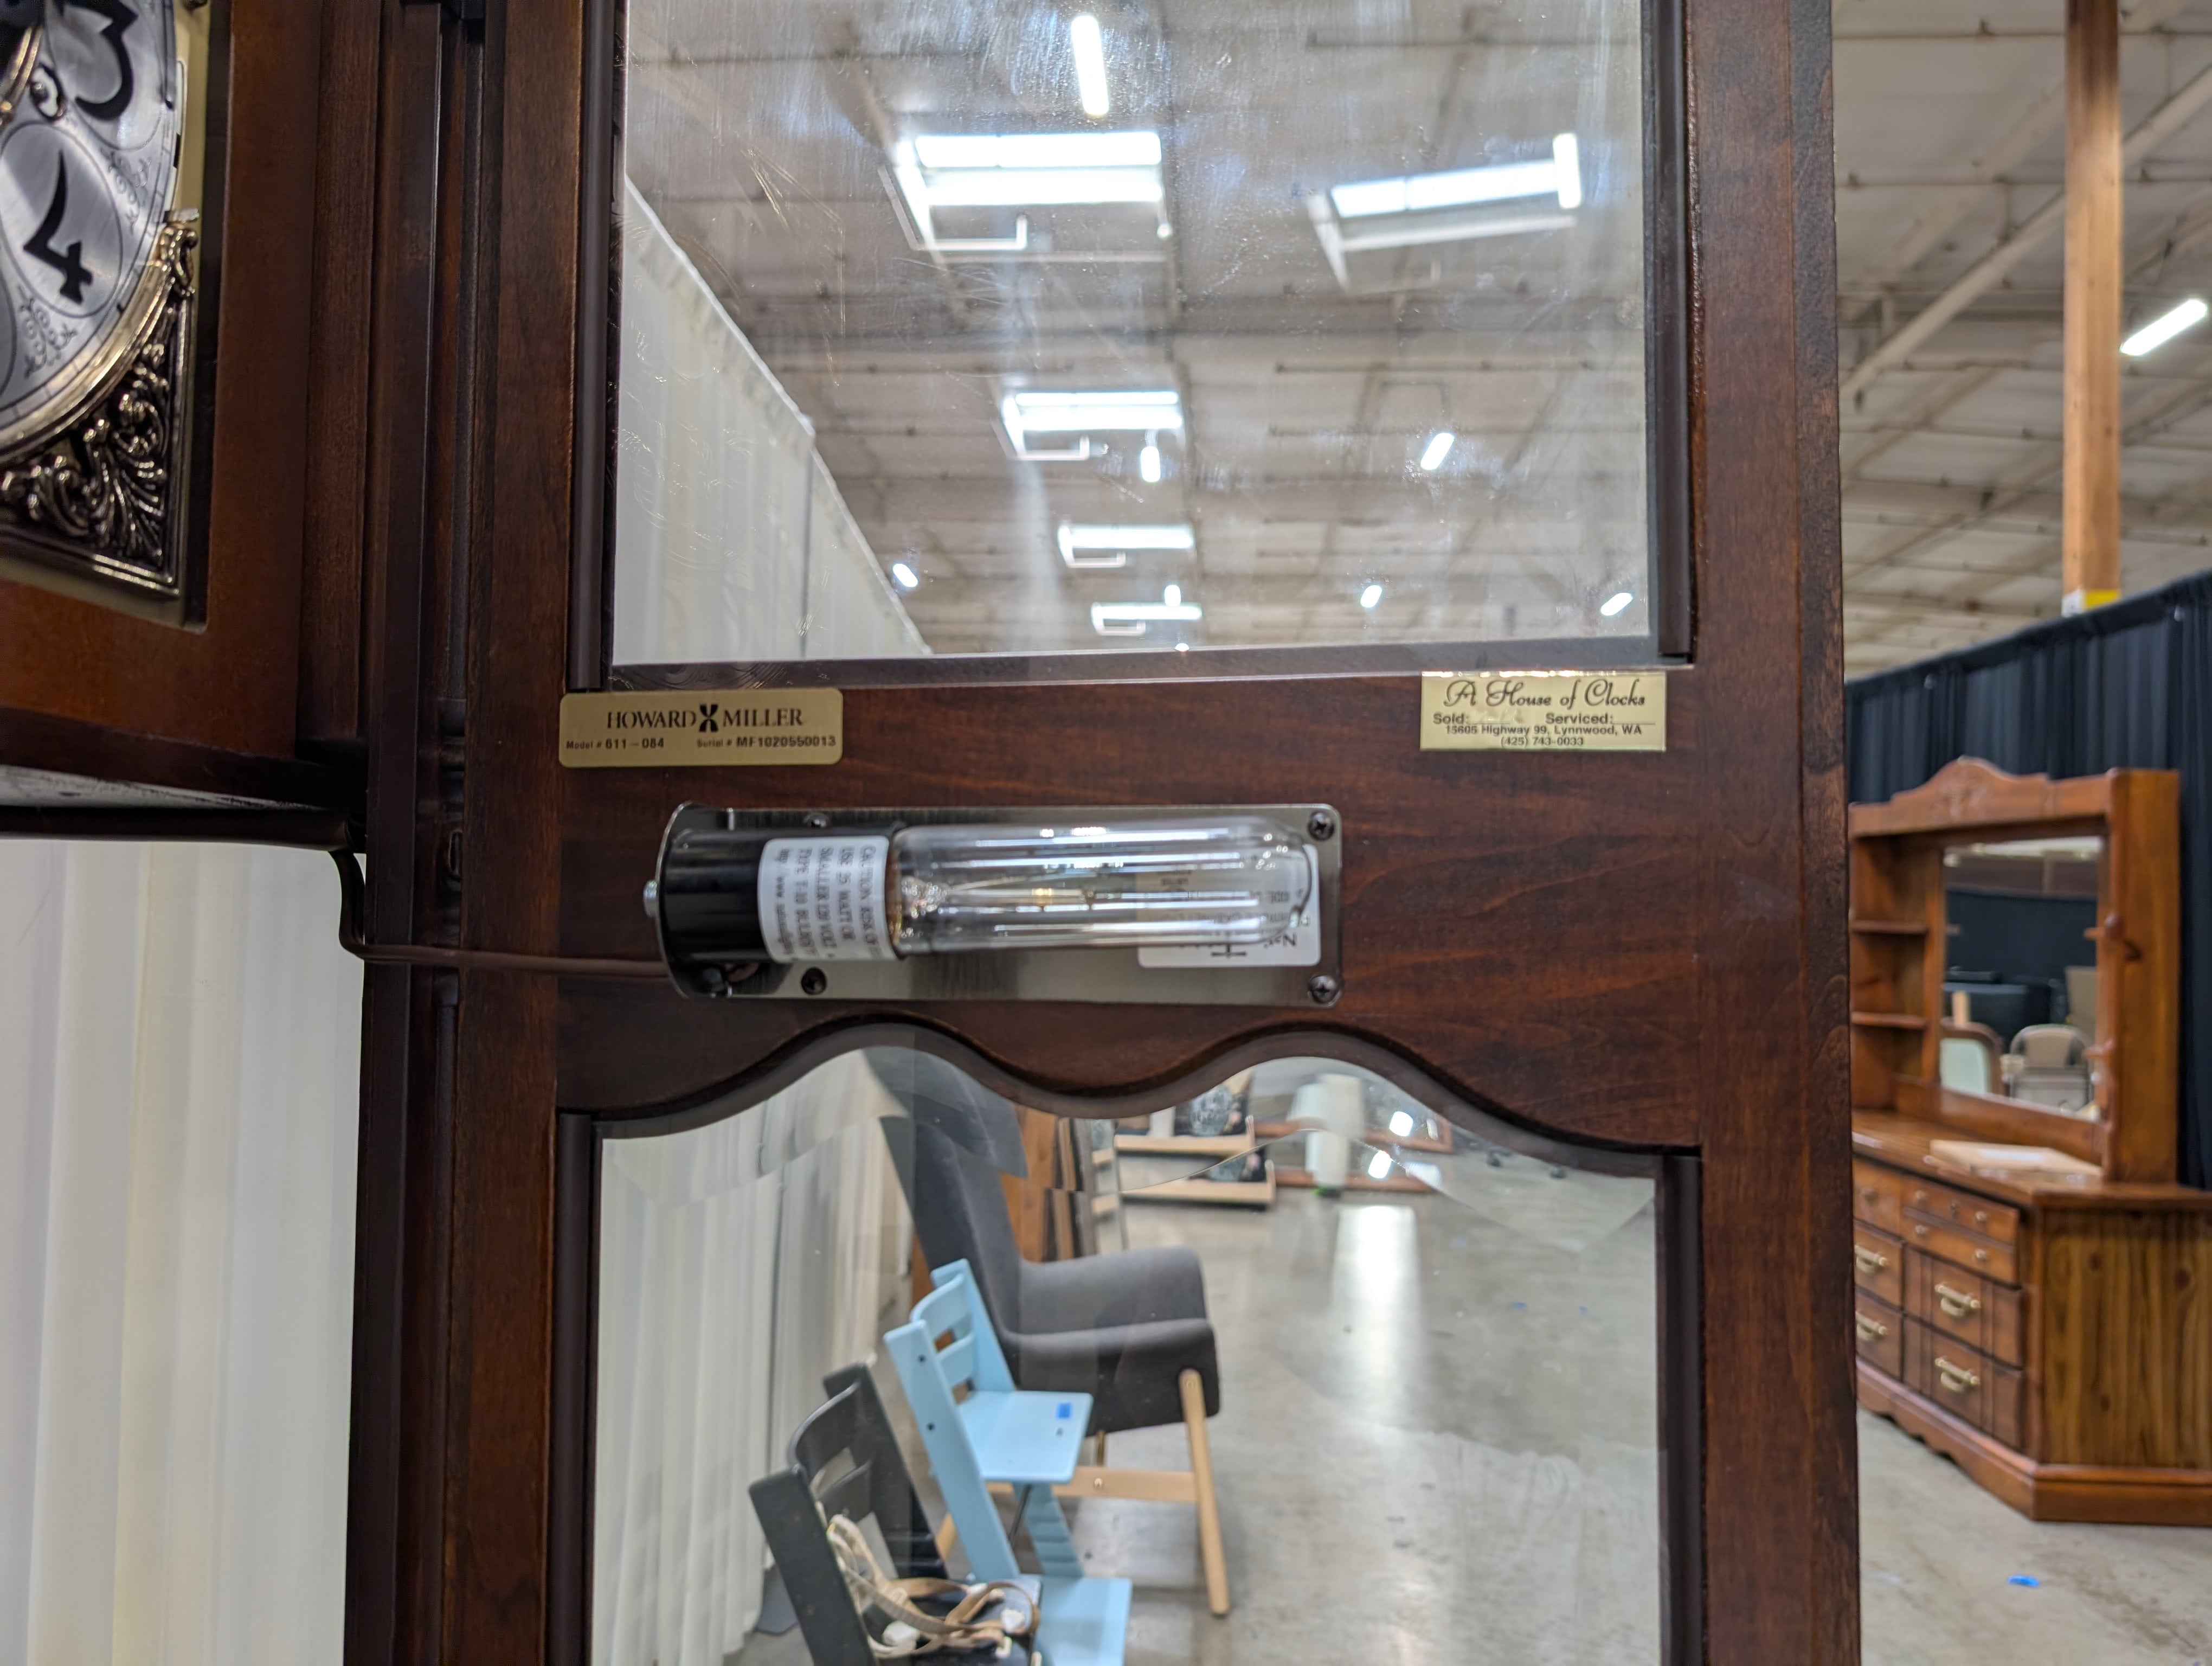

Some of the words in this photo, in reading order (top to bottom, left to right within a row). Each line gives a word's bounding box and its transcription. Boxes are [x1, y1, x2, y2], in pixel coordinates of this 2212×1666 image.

[23, 149, 93, 305] 4
[1443, 680, 1476, 706] A
[1486, 680, 1552, 706] House
[1559, 679, 1581, 710] of
[1584, 679, 1645, 707] Clocks
[607, 710, 697, 728] HOWARD
[723, 709, 803, 727] MILLER
[1433, 713, 1469, 725] Sold:
[1545, 713, 1613, 725] Serviced:
[1481, 726, 1529, 737] Highway
[1554, 725, 1618, 736] Lynnwood,
[1622, 725, 1642, 735] WA
[566, 741, 594, 750] Model
[605, 738, 627, 749] 611
[697, 739, 724, 748] Serial
[1500, 736, 1528, 748] (425)
[839, 846, 854, 866] USE
[860, 846, 876, 900] CAUTION
